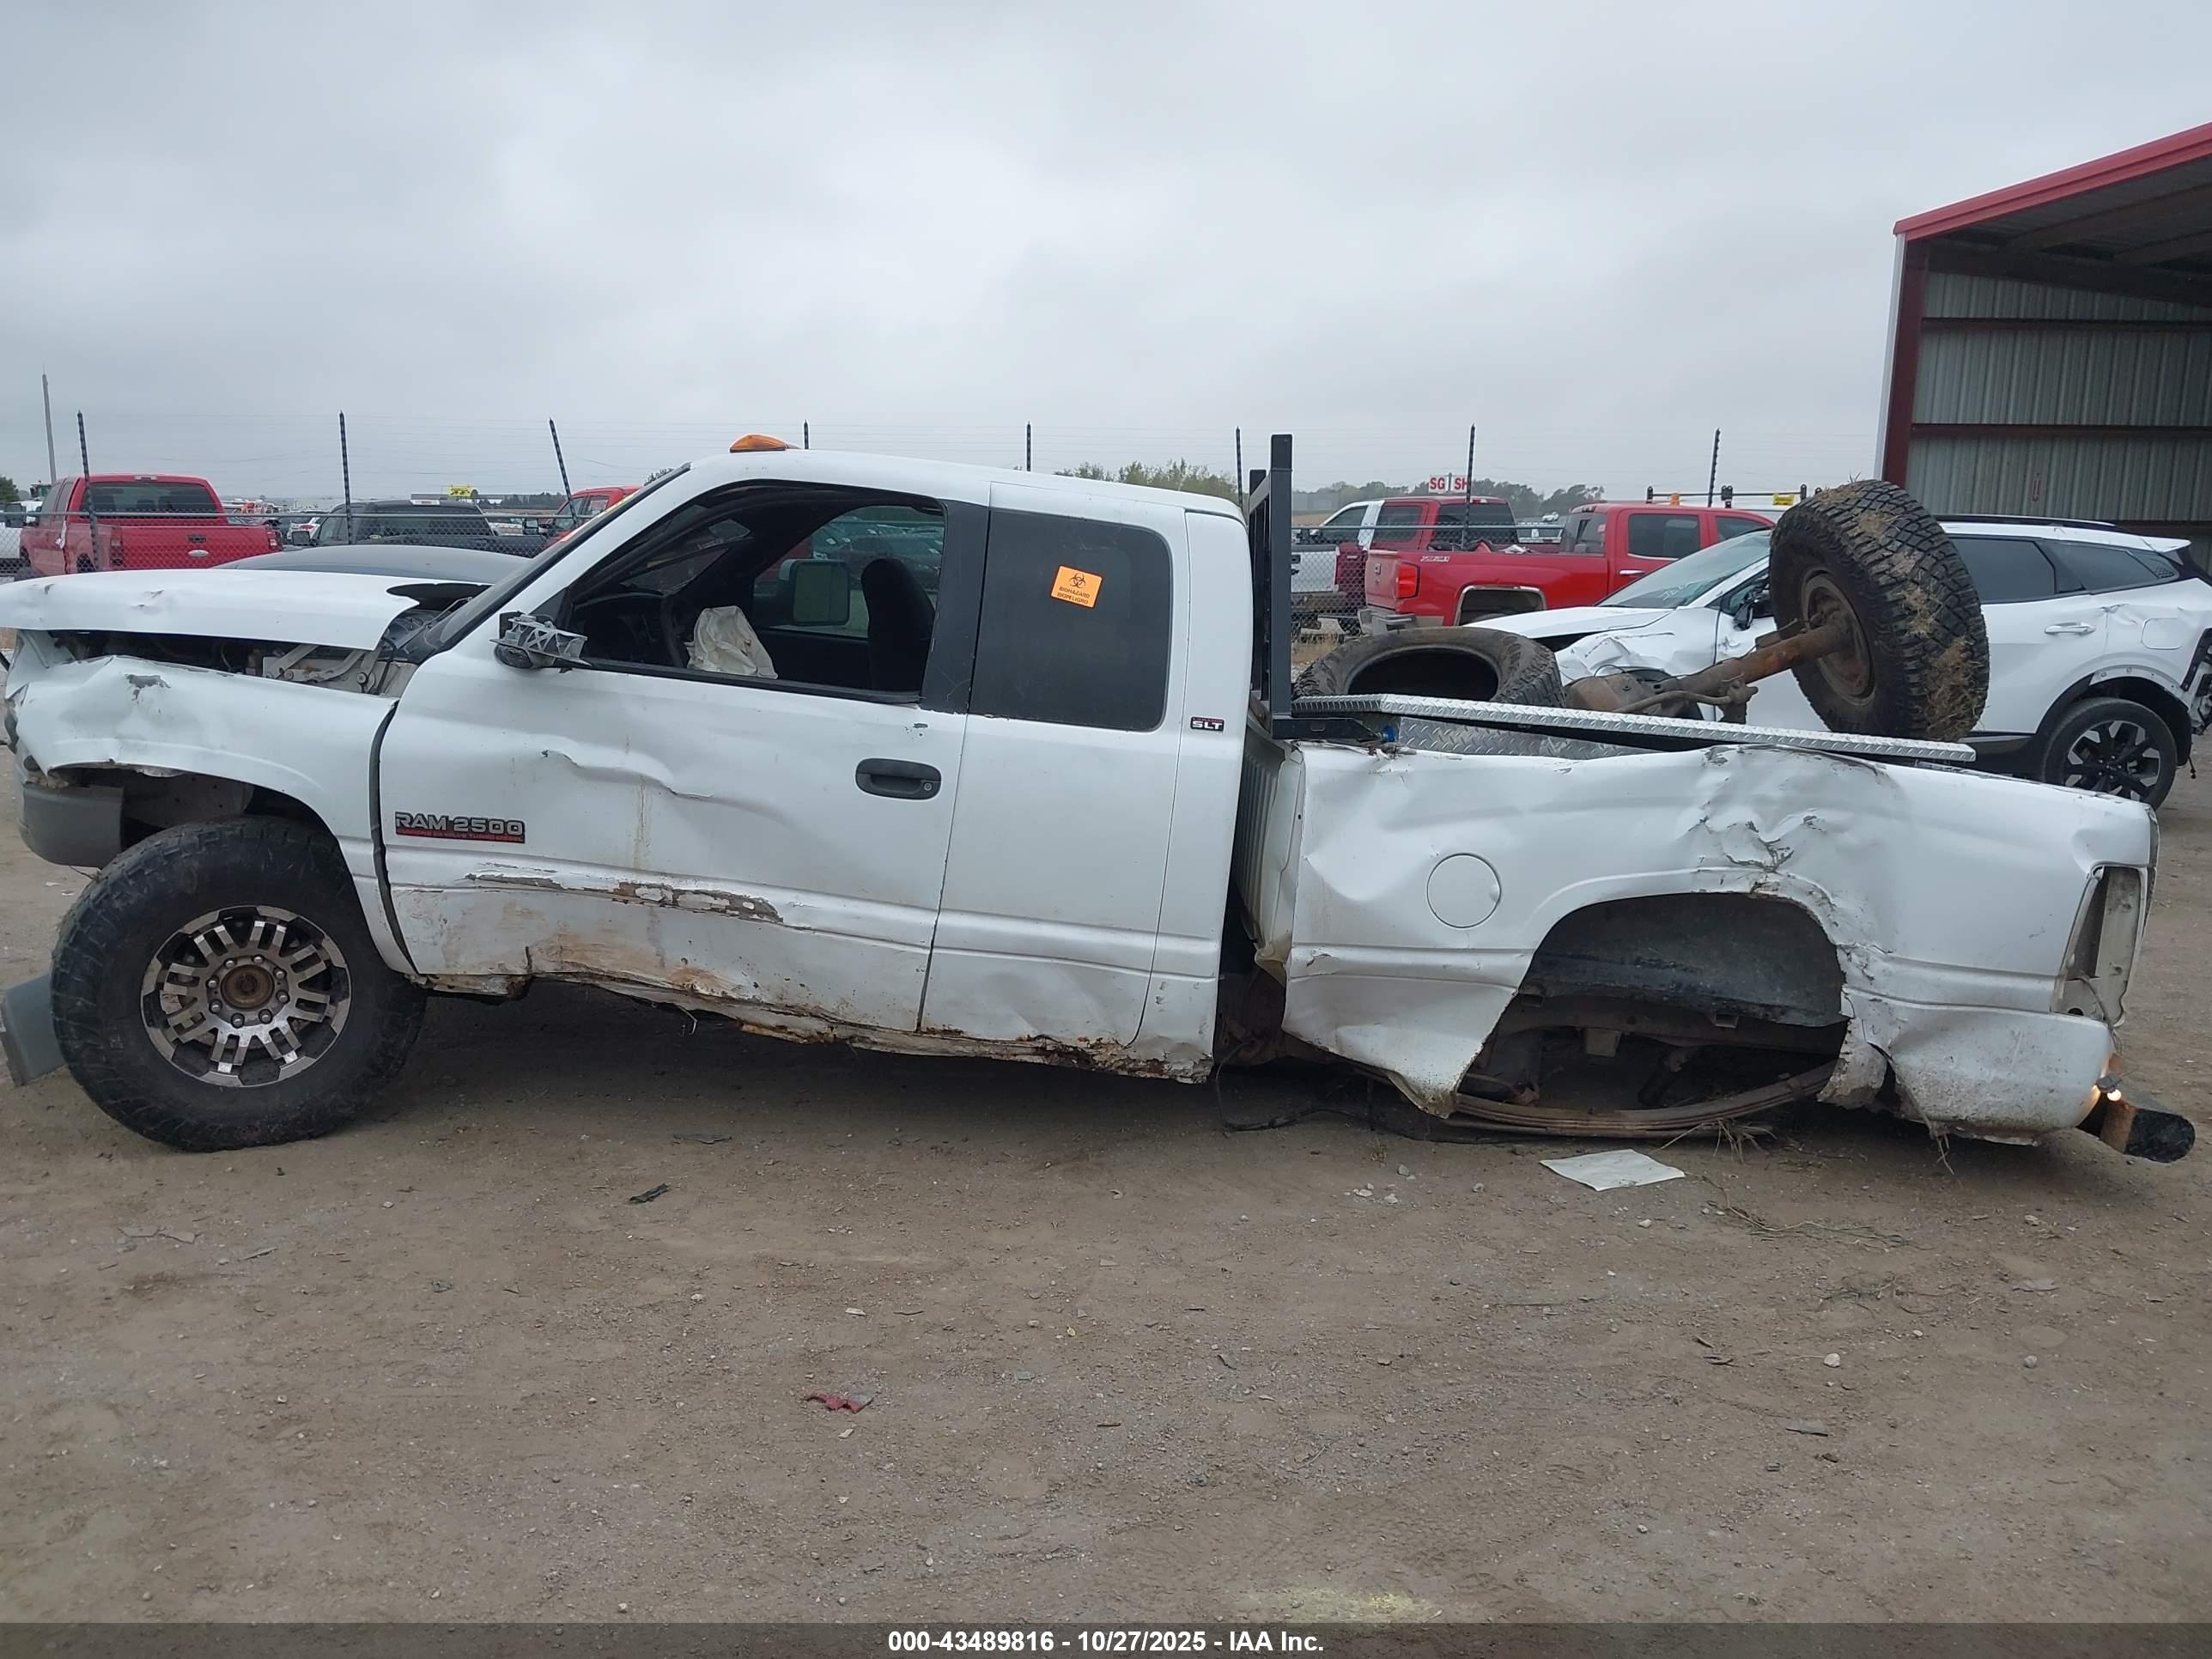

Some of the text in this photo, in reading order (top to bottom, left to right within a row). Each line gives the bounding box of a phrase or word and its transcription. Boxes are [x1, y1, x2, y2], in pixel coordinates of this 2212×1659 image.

[1430, 477, 1446, 490] SG
[1059, 586, 1091, 599] BIOHAZARD
[1192, 720, 1223, 730] SLT
[396, 813, 447, 831] RAM
[453, 817, 524, 836] 2500
